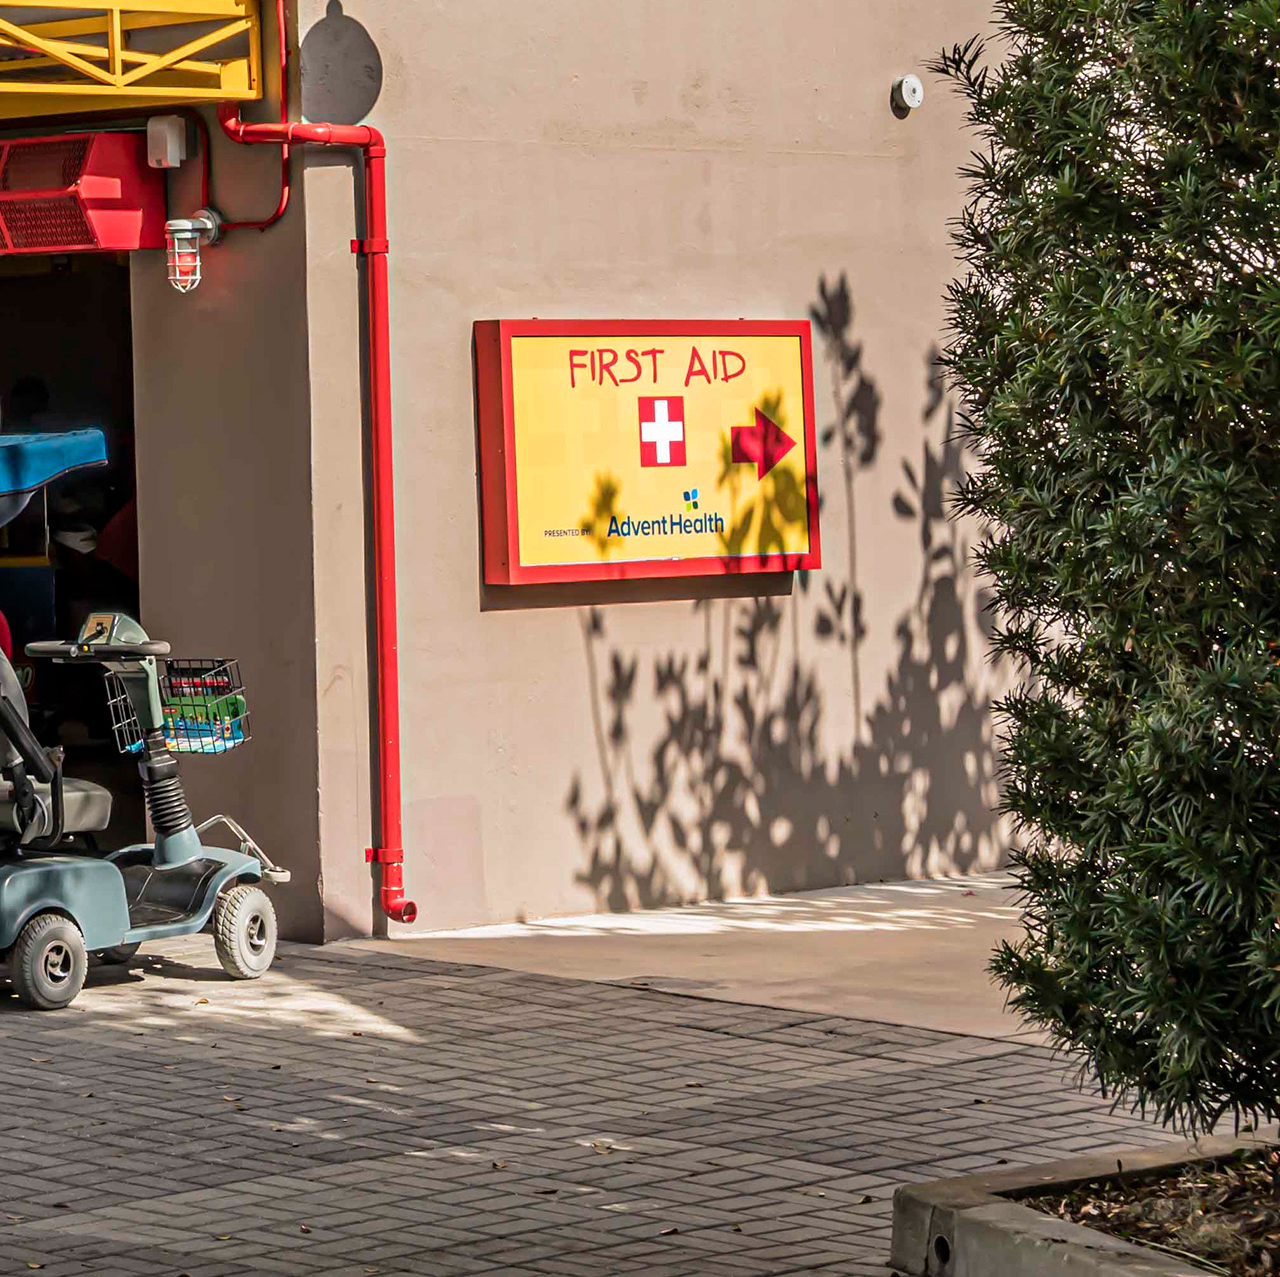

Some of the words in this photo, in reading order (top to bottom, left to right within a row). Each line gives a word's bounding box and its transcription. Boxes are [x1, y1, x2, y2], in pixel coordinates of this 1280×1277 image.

[568, 348, 665, 388] FIRST
[683, 346, 746, 387] AID
[543, 528, 580, 538] PRESENTED
